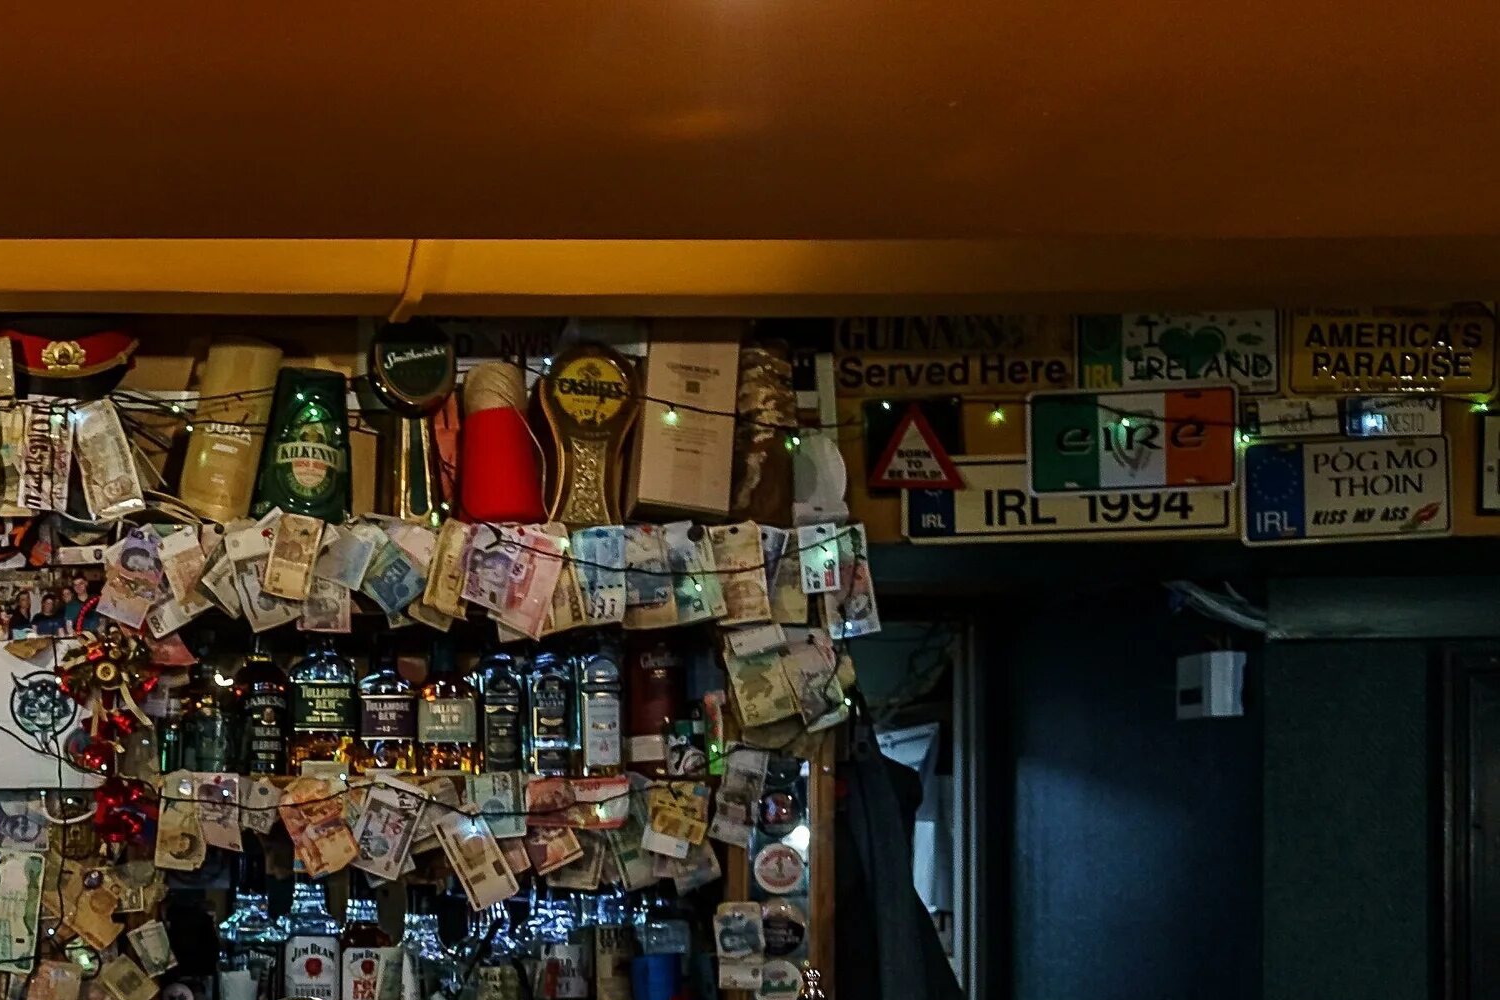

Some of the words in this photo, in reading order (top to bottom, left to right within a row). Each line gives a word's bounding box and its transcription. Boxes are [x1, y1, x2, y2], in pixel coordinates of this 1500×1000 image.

[1305, 322, 1482, 349] AMERICA'S
[838, 355, 970, 388] Served
[980, 352, 1064, 384] Here
[1128, 350, 1273, 382] IRELAND
[1313, 351, 1473, 377] PARADISE
[897, 449, 931, 459] BORN
[906, 460, 923, 469] TO
[1386, 448, 1438, 470] MO
[1329, 473, 1425, 498] THOIN
[984, 489, 1057, 525] IRL
[1079, 491, 1194, 523] 1994
[1312, 510, 1347, 525] KISS
[1380, 507, 1409, 521] ASS
[921, 514, 948, 528] IRL
[1255, 511, 1298, 533] IRL
[292, 945, 309, 962] JIM
